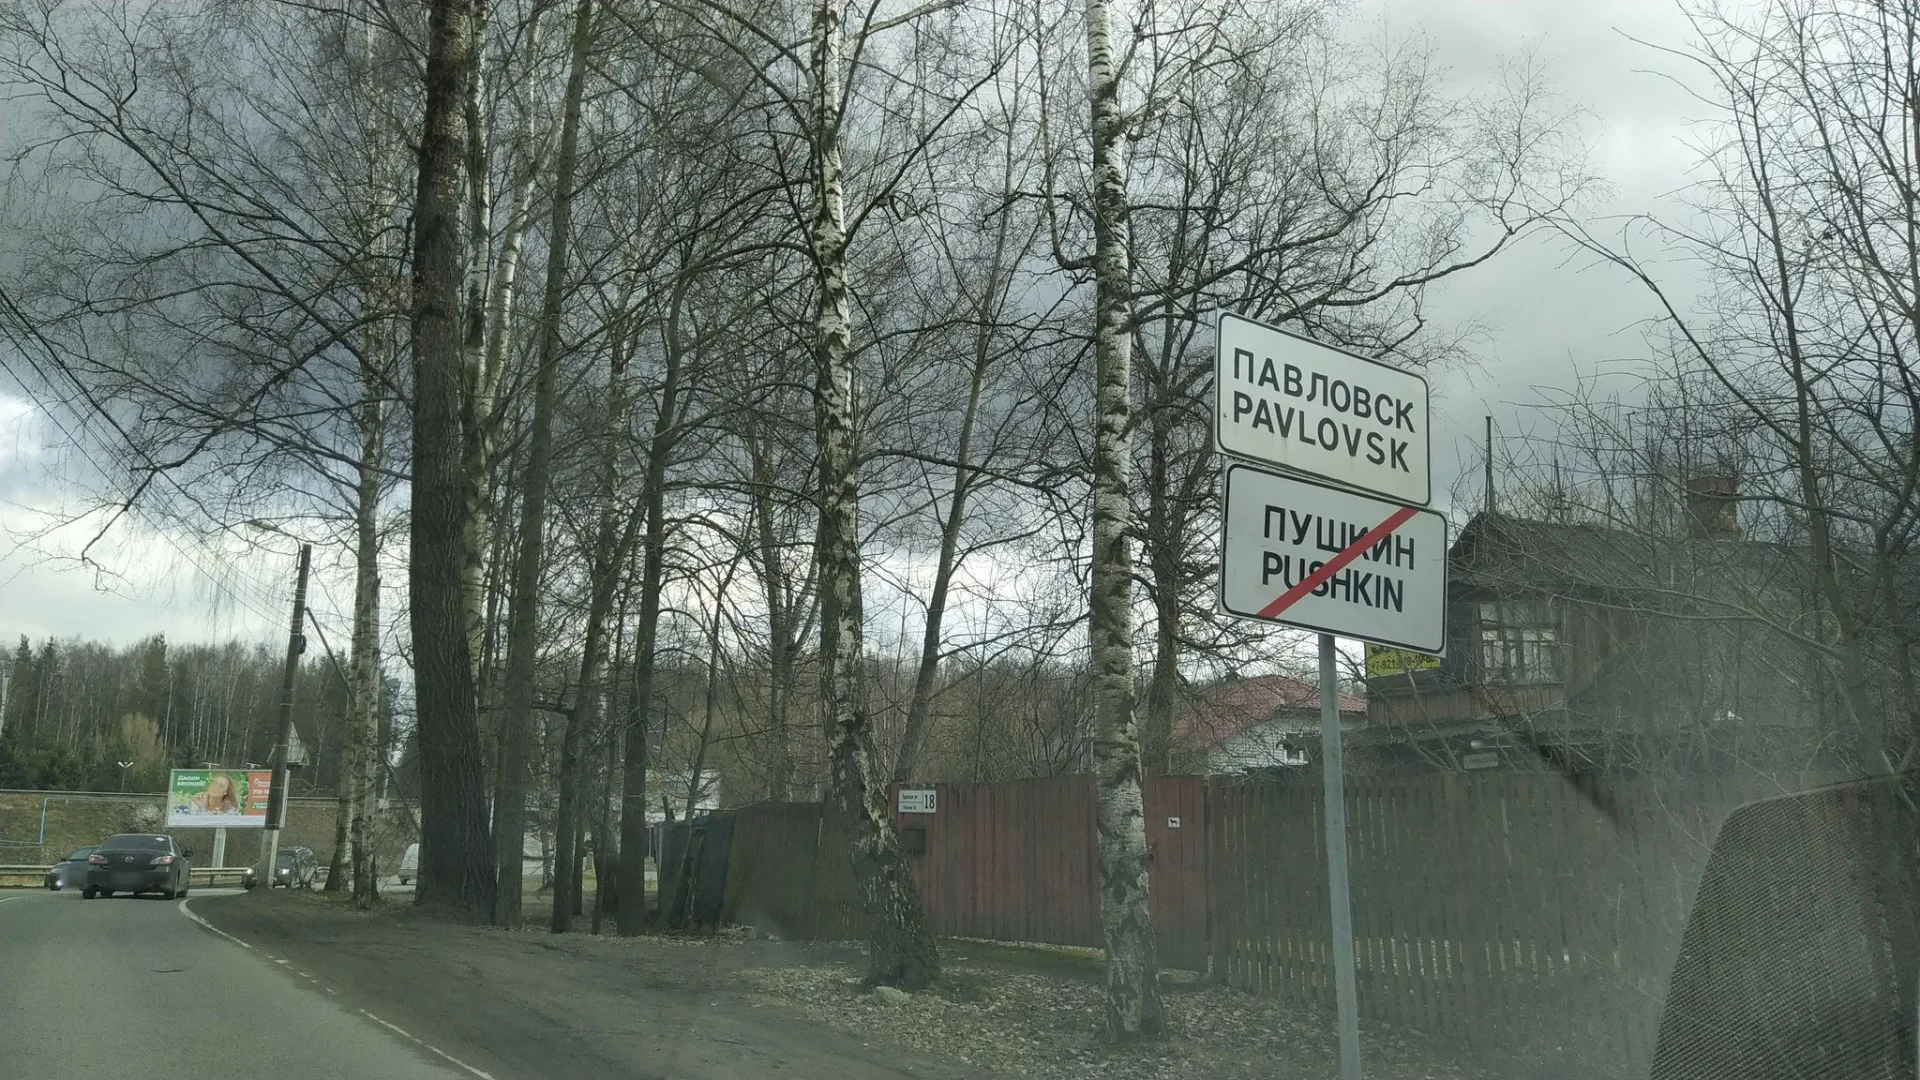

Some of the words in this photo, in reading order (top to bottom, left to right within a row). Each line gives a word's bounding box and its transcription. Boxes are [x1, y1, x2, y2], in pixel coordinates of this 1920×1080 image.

[1233, 347, 1416, 433] ПАВЛОВСК
[1232, 390, 1411, 473] PAVLOVSK
[1263, 504, 1415, 570] ПУШКИН
[1261, 551, 1403, 612] PUSHKIN
[924, 794, 935, 810] 18
